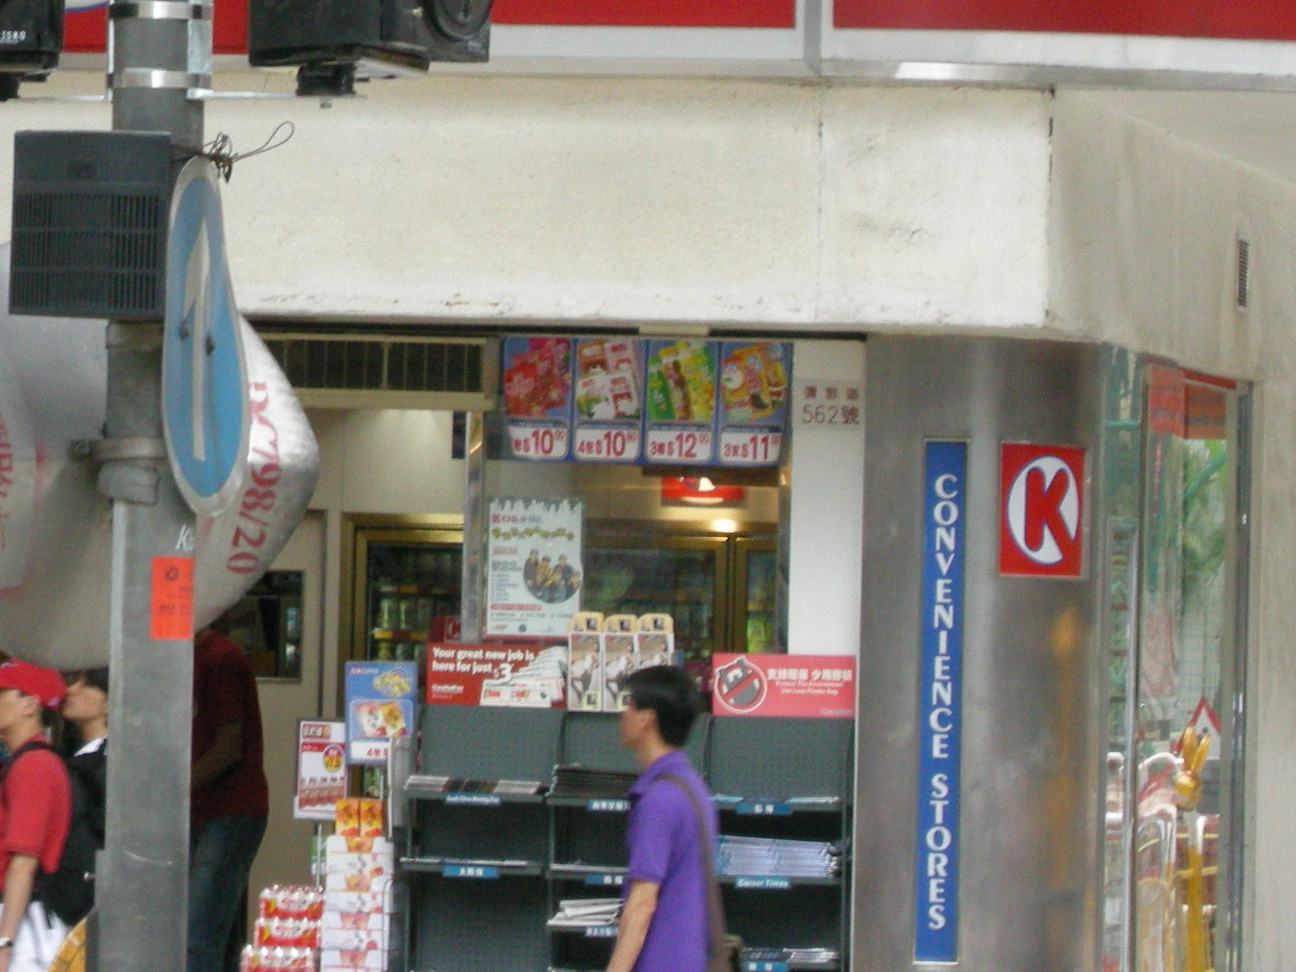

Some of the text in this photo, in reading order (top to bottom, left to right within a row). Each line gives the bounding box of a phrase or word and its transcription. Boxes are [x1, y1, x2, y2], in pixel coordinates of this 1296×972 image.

[432, 647, 456, 658] Your
[457, 648, 483, 661] great
[485, 650, 507, 660] new
[507, 649, 524, 662] job
[930, 474, 959, 759] CONVENIENCE
[432, 660, 455, 671] here
[456, 661, 471, 672] for
[926, 774, 953, 931] STORES
